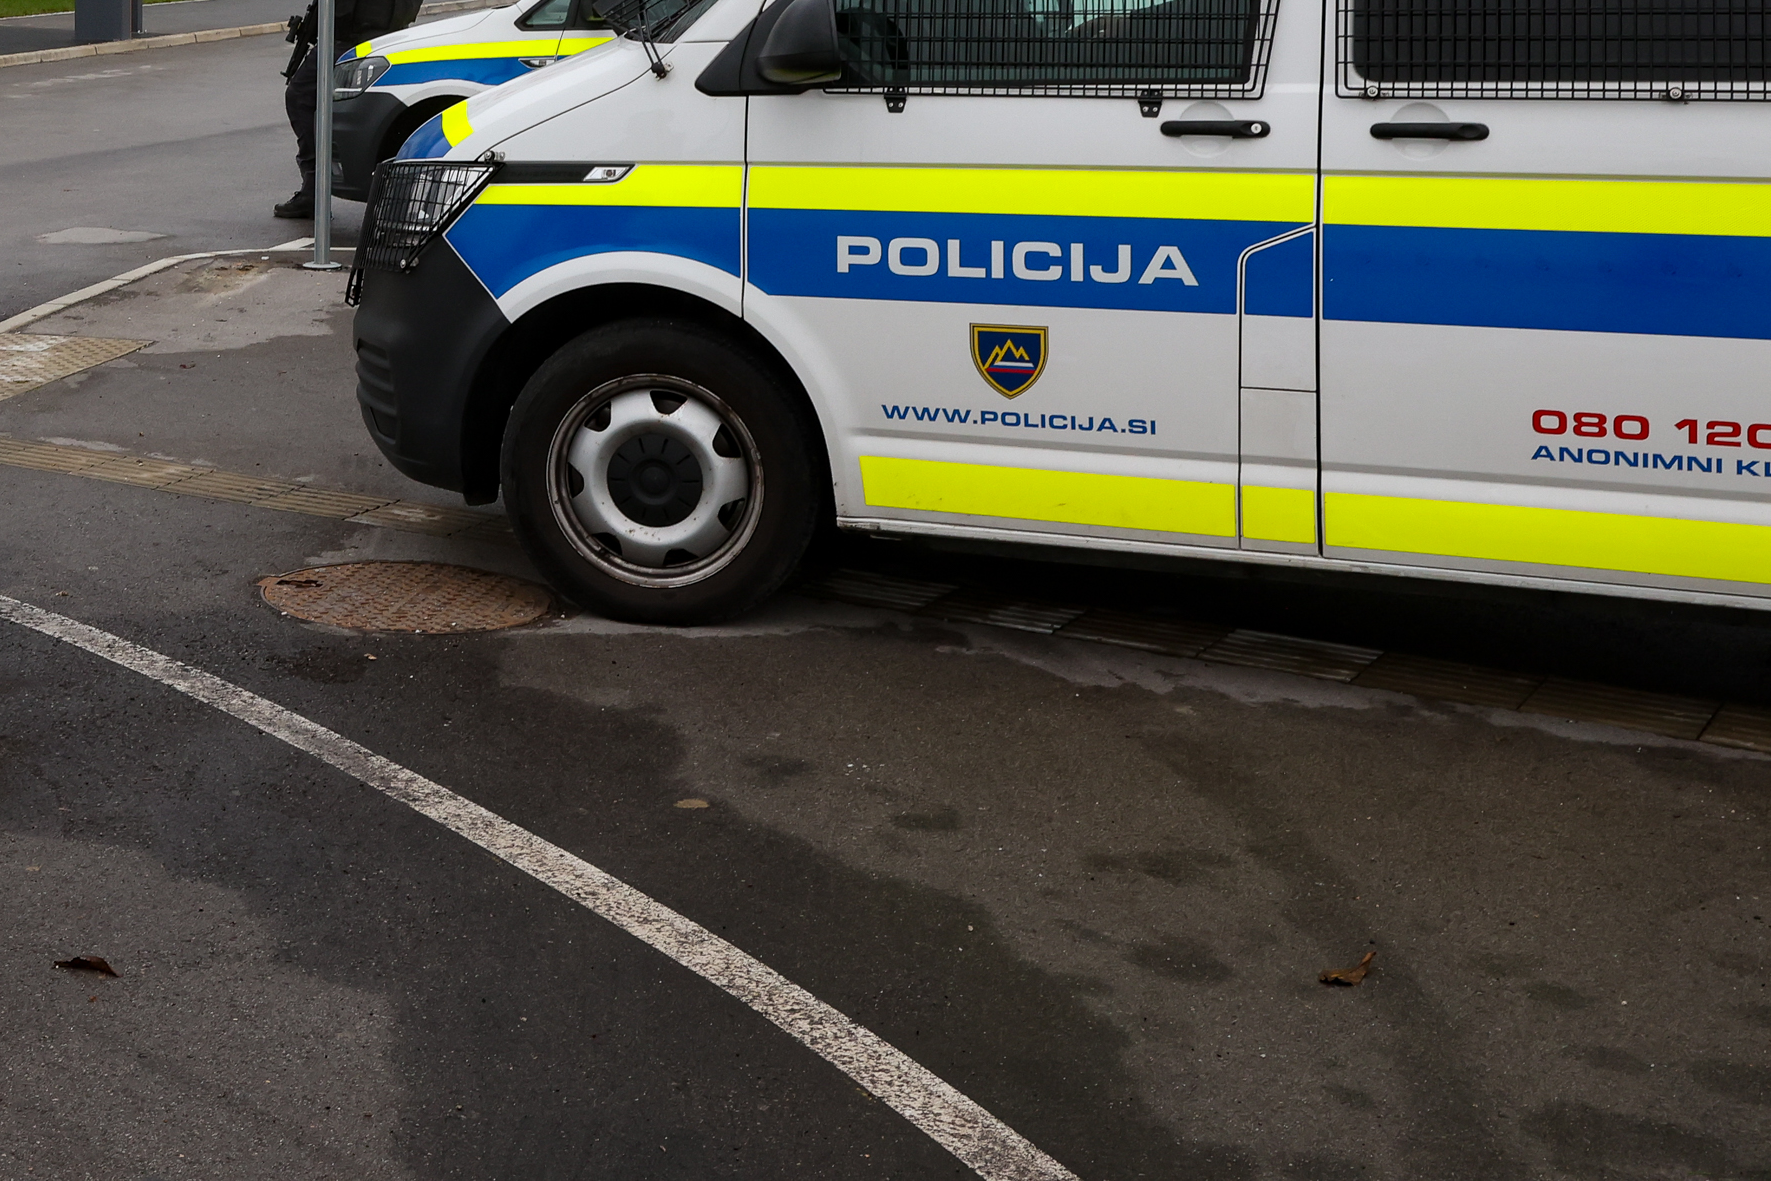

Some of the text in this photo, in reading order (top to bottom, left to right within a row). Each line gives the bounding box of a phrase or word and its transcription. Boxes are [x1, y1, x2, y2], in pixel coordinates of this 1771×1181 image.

[836, 235, 1199, 286] POLICIJA
[882, 405, 1157, 436] WWW.POLICIJA.SI
[1532, 409, 1771, 450] 080 120
[1531, 445, 1723, 474] ANONIMNI
